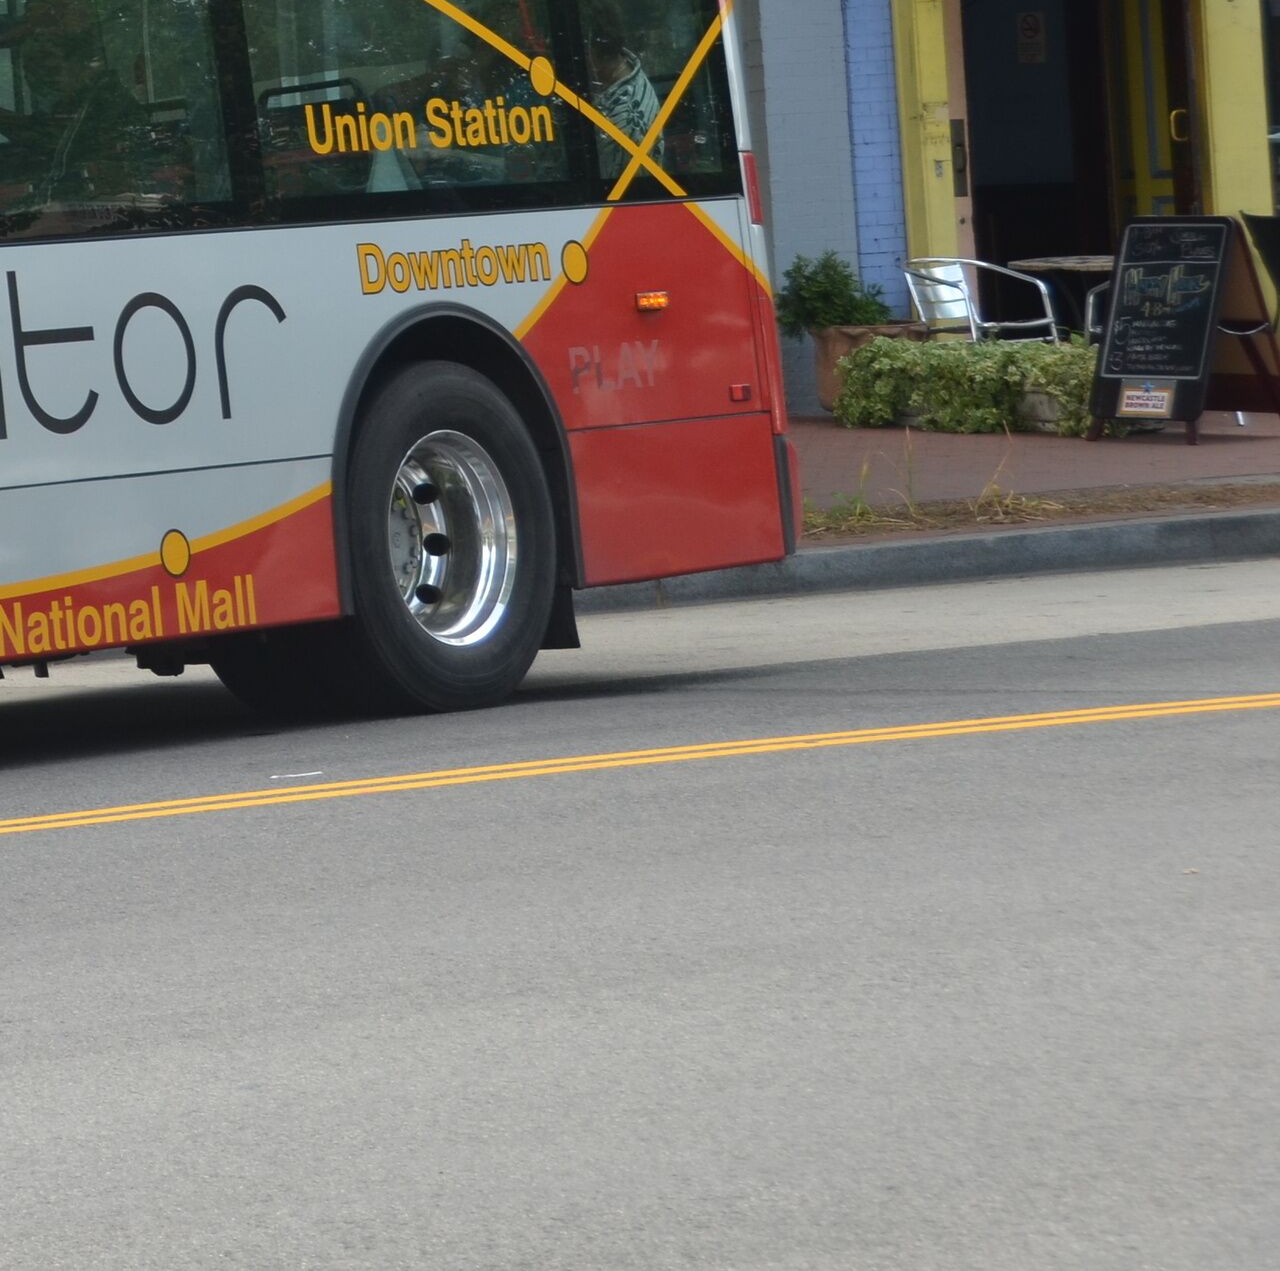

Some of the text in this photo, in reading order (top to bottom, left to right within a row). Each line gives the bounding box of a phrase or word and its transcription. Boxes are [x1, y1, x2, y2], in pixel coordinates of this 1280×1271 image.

[305, 96, 555, 155] Union Station
[356, 238, 551, 295] Downtown
[567, 339, 659, 394] PLAY
[174, 574, 258, 636] Mall
